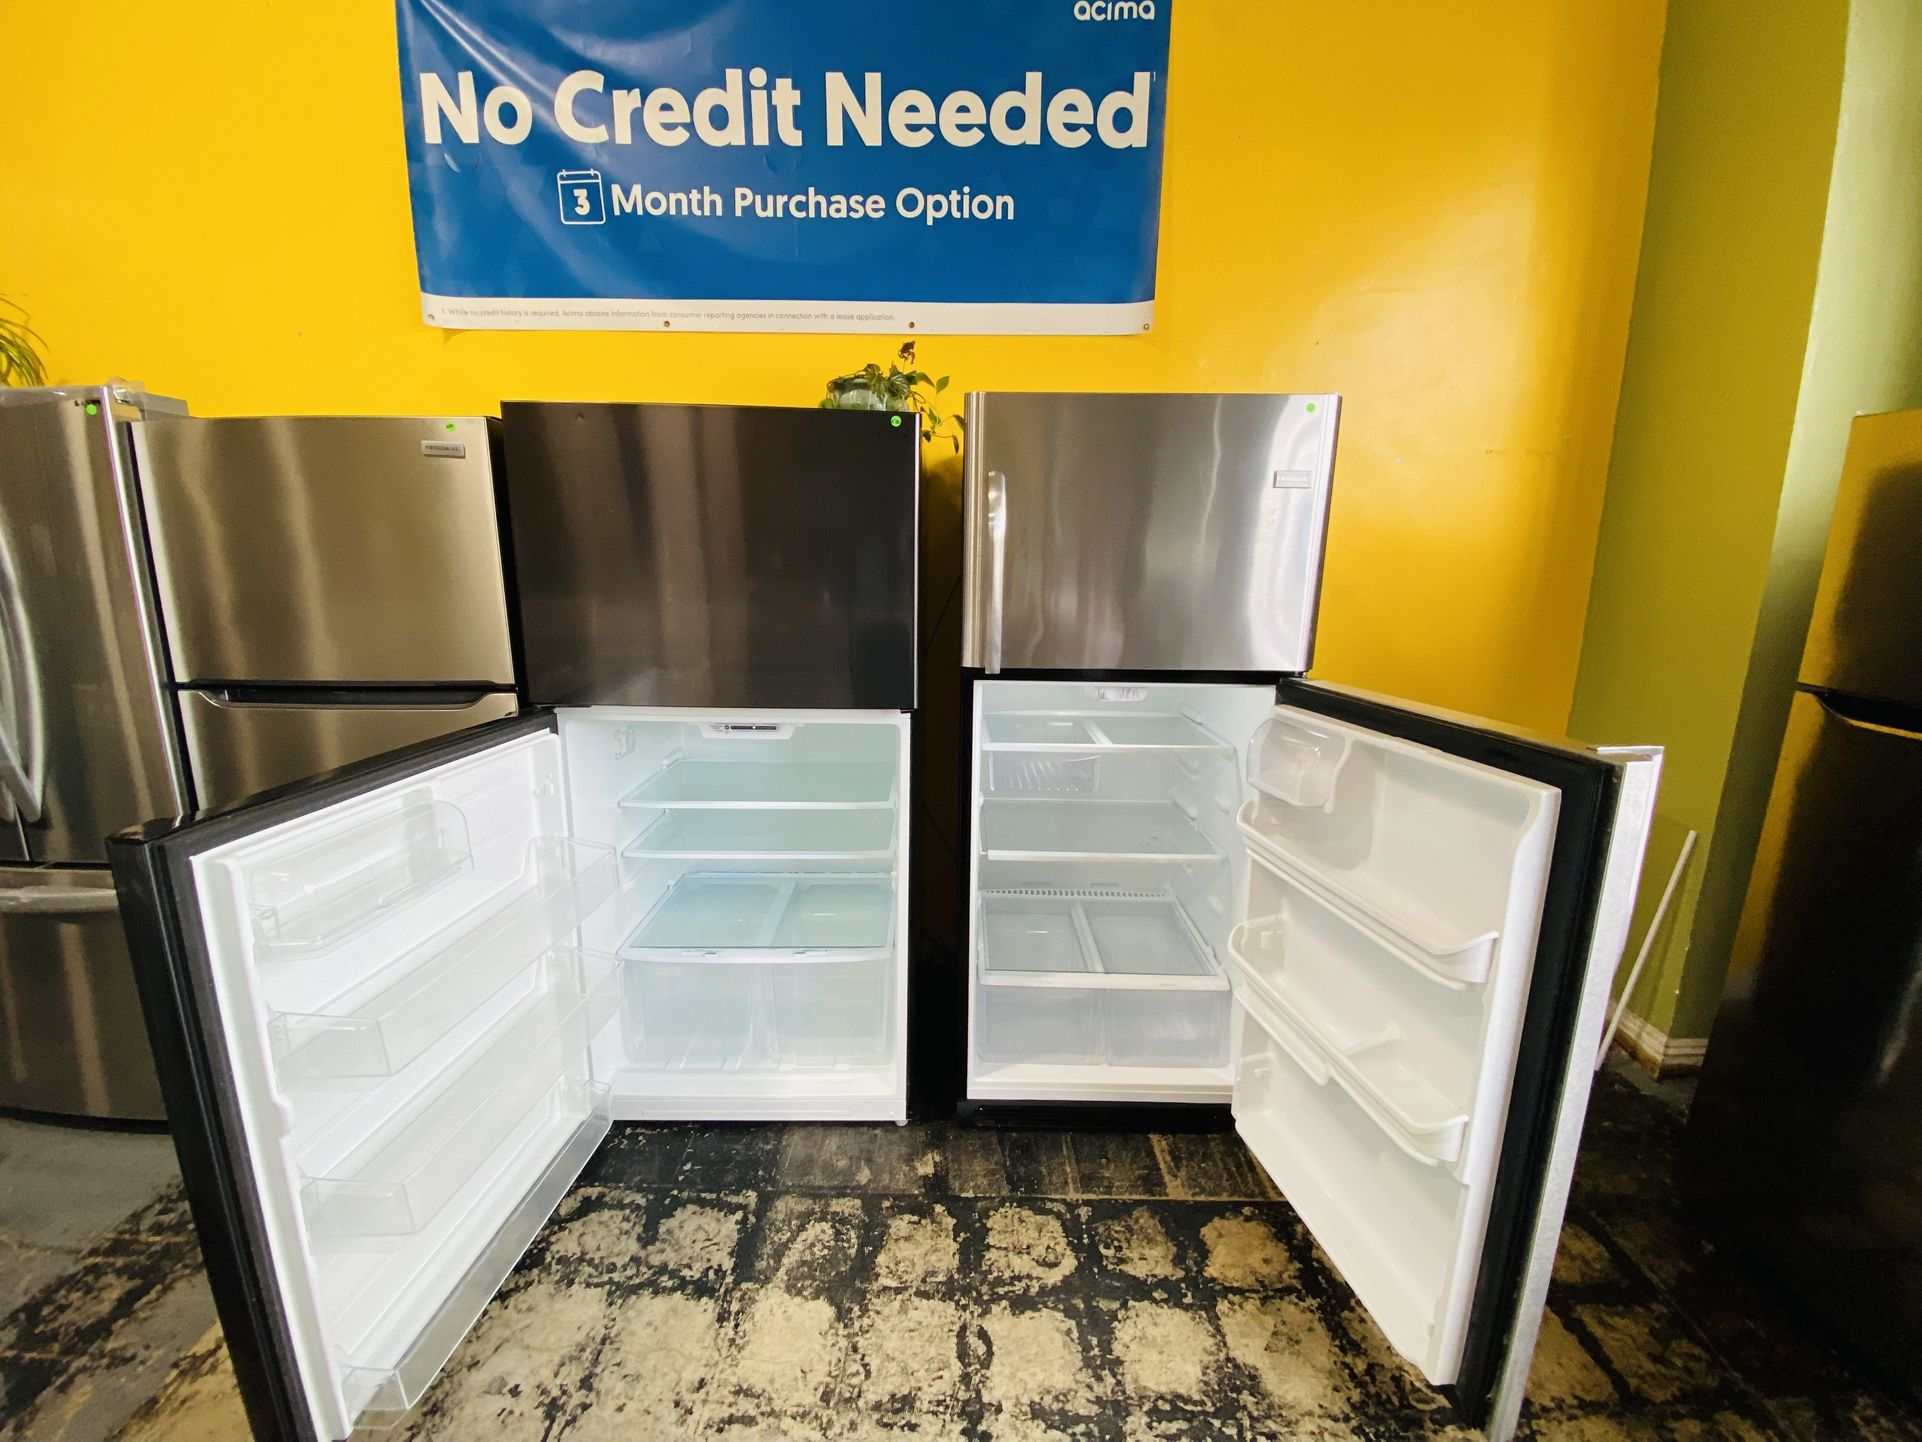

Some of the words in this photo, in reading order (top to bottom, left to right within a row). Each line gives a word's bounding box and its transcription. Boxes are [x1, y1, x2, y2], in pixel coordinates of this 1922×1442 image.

[1073, 0, 1156, 21] acima
[419, 70, 533, 146] No
[554, 67, 803, 147] Credit
[825, 71, 1151, 149] Needed
[573, 188, 591, 216] 3
[611, 183, 723, 217] Month
[734, 186, 887, 219] Purchase
[895, 185, 1016, 227] Option
[448, 308, 468, 316] While
[480, 308, 499, 316] credit
[500, 309, 522, 318] history
[524, 309, 529, 317] is
[530, 309, 561, 318] required,
[585, 310, 609, 318] obtains
[611, 310, 650, 318] information
[651, 310, 668, 318] from
[704, 312, 735, 321] reporting
[736, 312, 767, 320] agencies
[856, 313, 895, 322] application.
